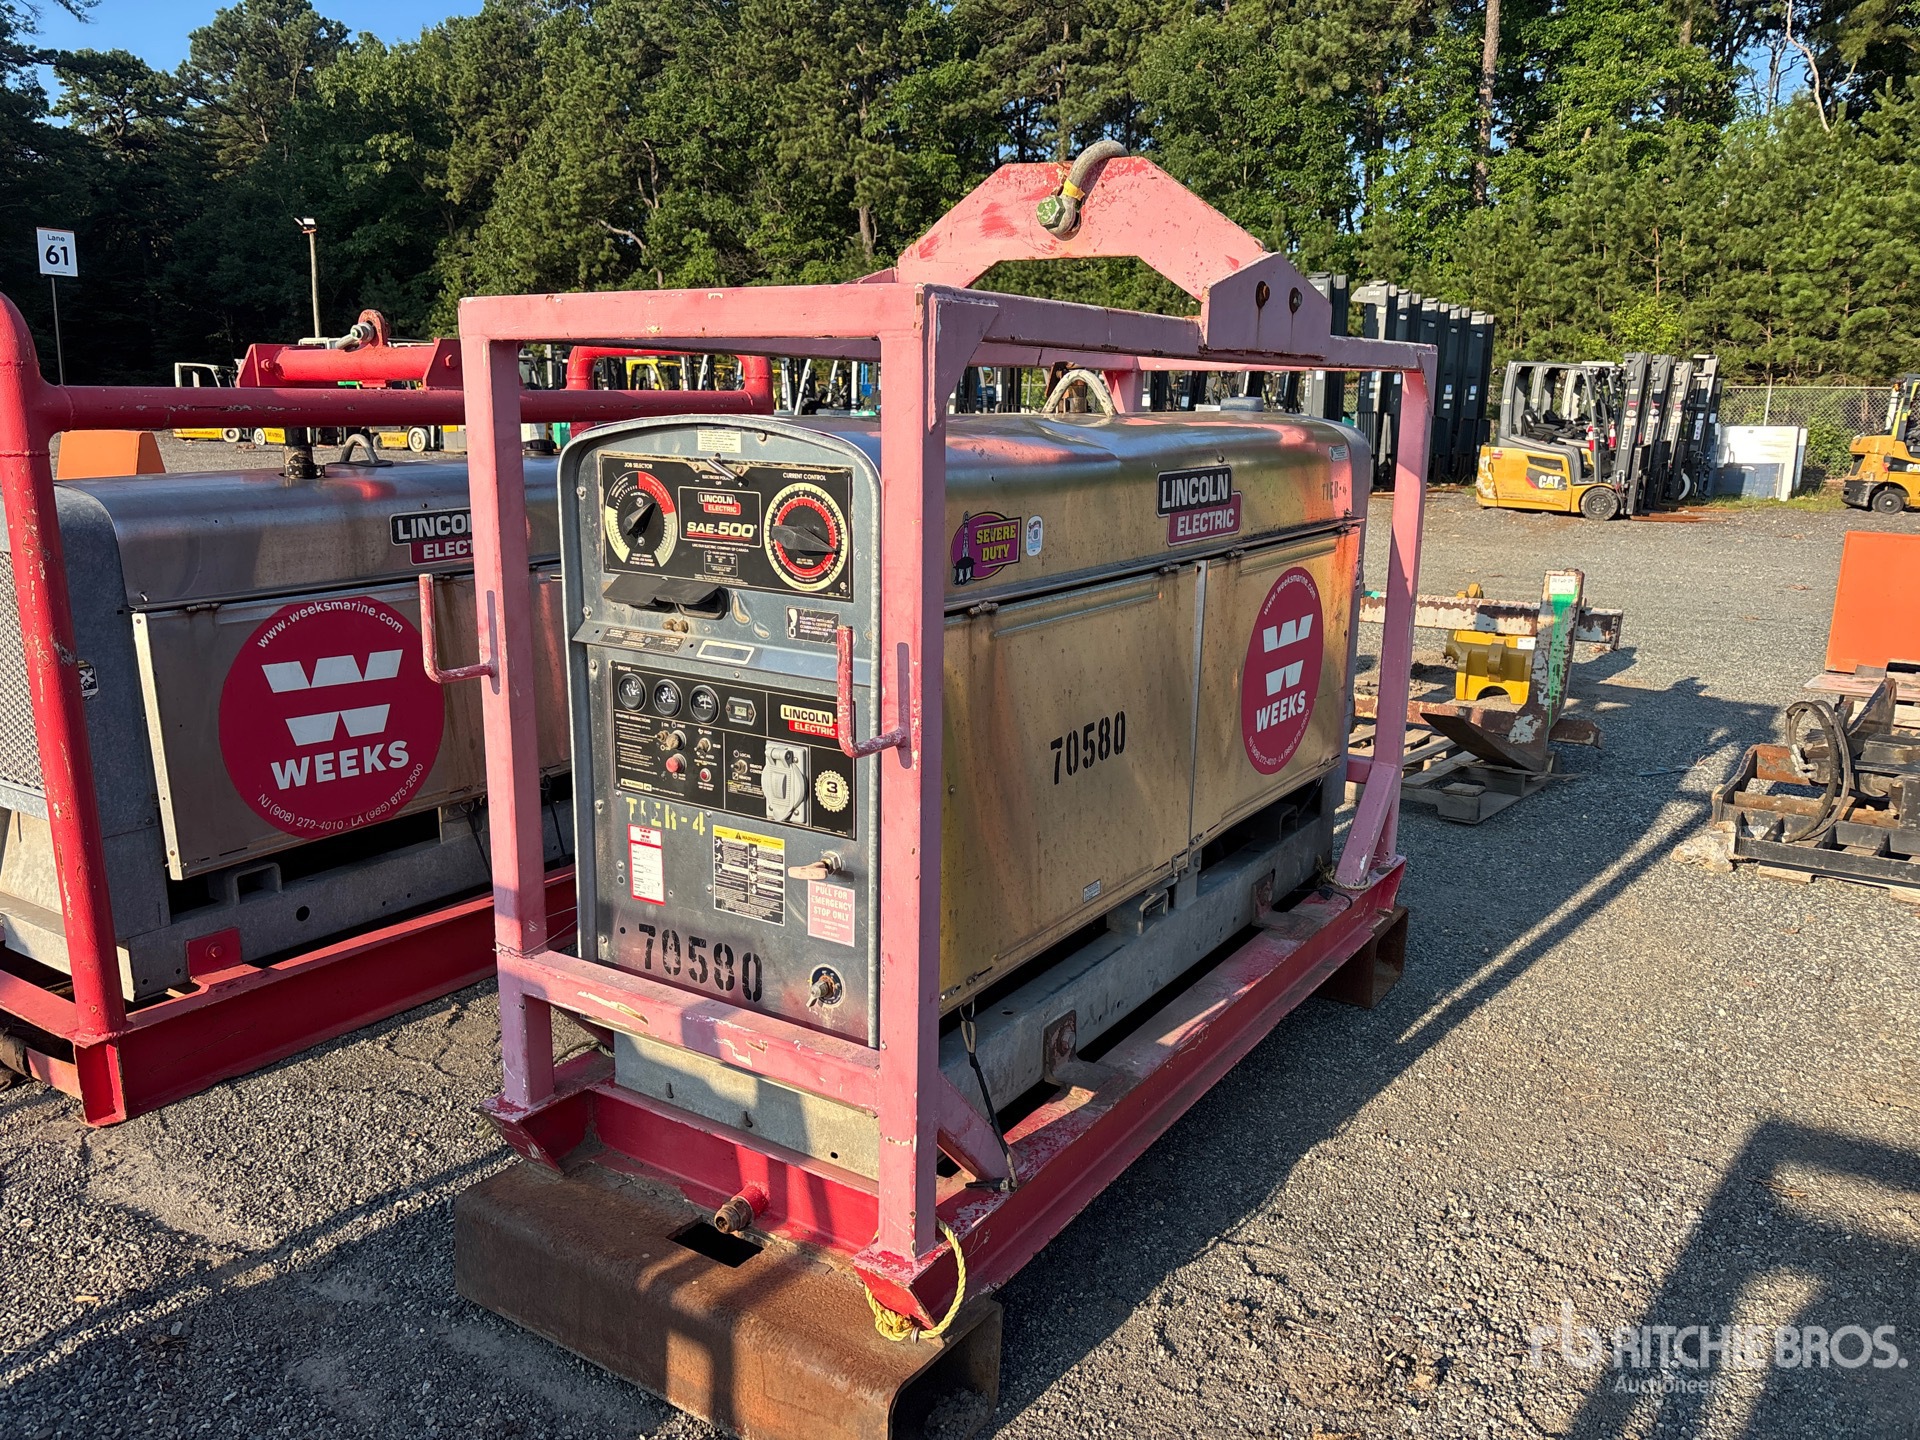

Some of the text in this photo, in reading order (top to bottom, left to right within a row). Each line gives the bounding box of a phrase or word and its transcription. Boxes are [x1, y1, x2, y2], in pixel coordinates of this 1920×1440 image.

[47, 233, 65, 242] Lane
[46, 244, 69, 266] 61
[783, 472, 827, 481] CURRENT CONTROL
[1538, 475, 1561, 488] CAT
[699, 493, 733, 505] LINCOLN
[1161, 473, 1229, 509] LINCOLN
[707, 504, 737, 513] ELECTRIC
[1176, 508, 1235, 537] ELECTRIC
[976, 524, 1017, 545] SEVERE
[982, 544, 1010, 562] DUTY
[257, 600, 404, 648] www.weeksmarine.com
[783, 707, 830, 724] LINCOLN
[1256, 690, 1307, 733] WEEKS
[794, 723, 836, 736] ELECTRIC
[1050, 710, 1126, 786] 70580
[270, 740, 410, 791] WEEKS
[826, 781, 838, 794] 3
[257, 763, 424, 830] NJ (908) 272-4010 LA (985) 875-2500
[815, 885, 848, 900] PULL FOR
[811, 895, 853, 912] EMERGENCY
[813, 905, 850, 922] STOP ONLY
[638, 923, 763, 1003] 70580
